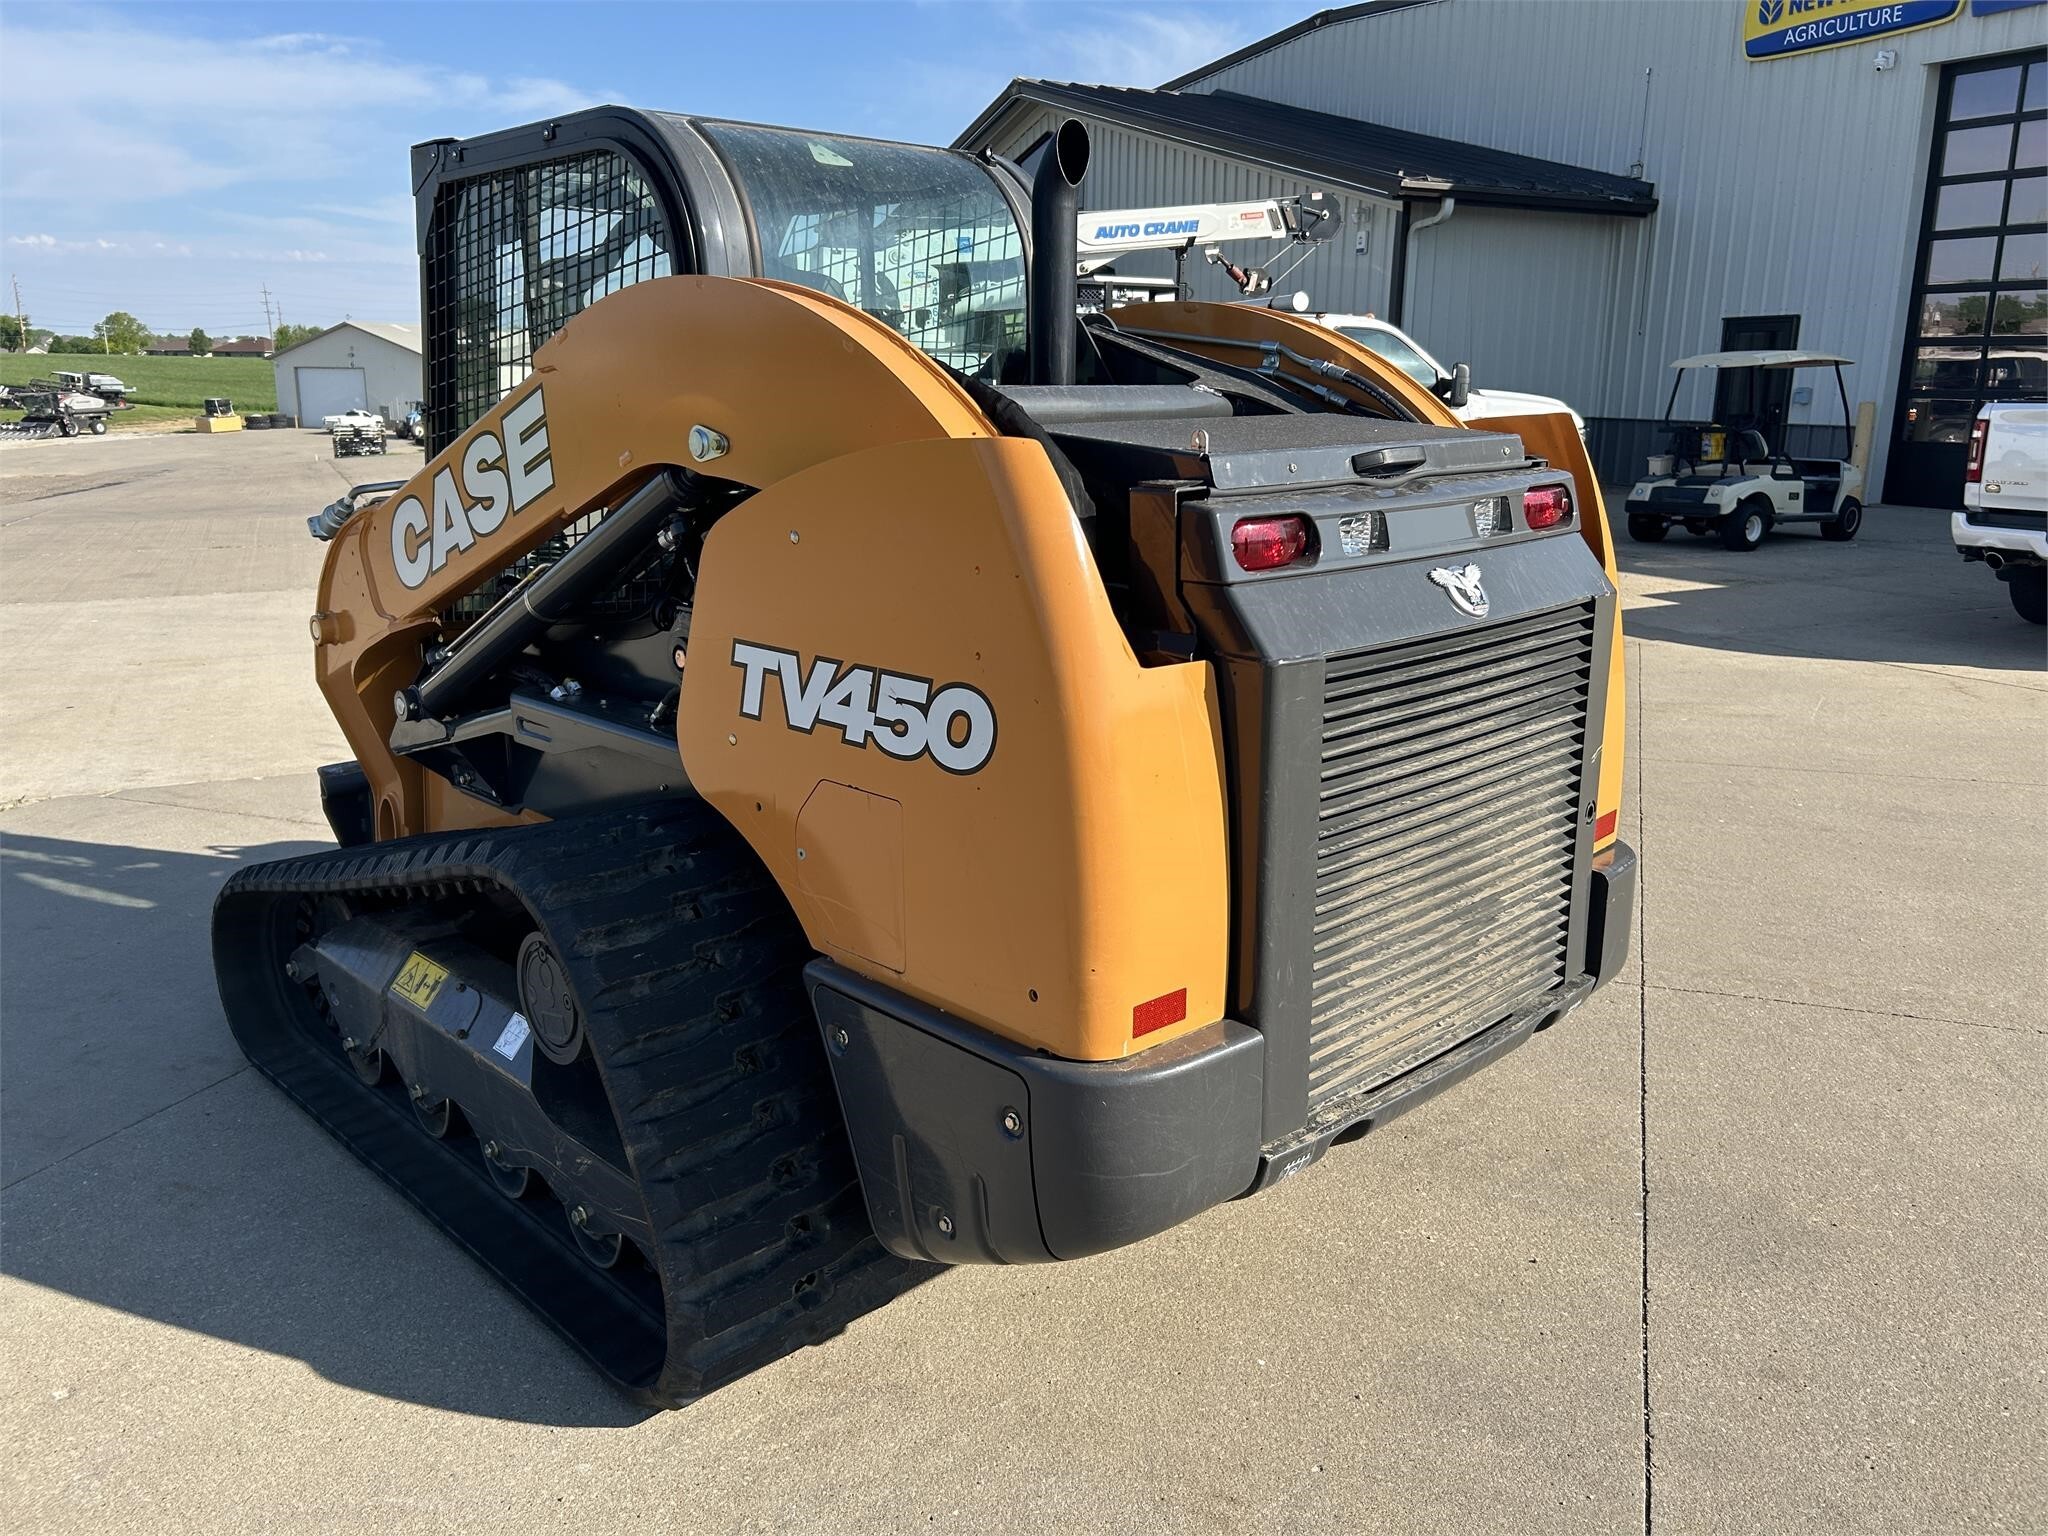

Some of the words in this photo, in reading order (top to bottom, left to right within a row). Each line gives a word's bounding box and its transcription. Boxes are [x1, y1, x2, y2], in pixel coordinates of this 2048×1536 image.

[1784, 5, 1903, 45] AGRICULTURE
[1095, 224, 1140, 239] AUTO
[1143, 220, 1200, 236] CRANE
[391, 383, 556, 589] CASE
[730, 638, 998, 776] TV450
